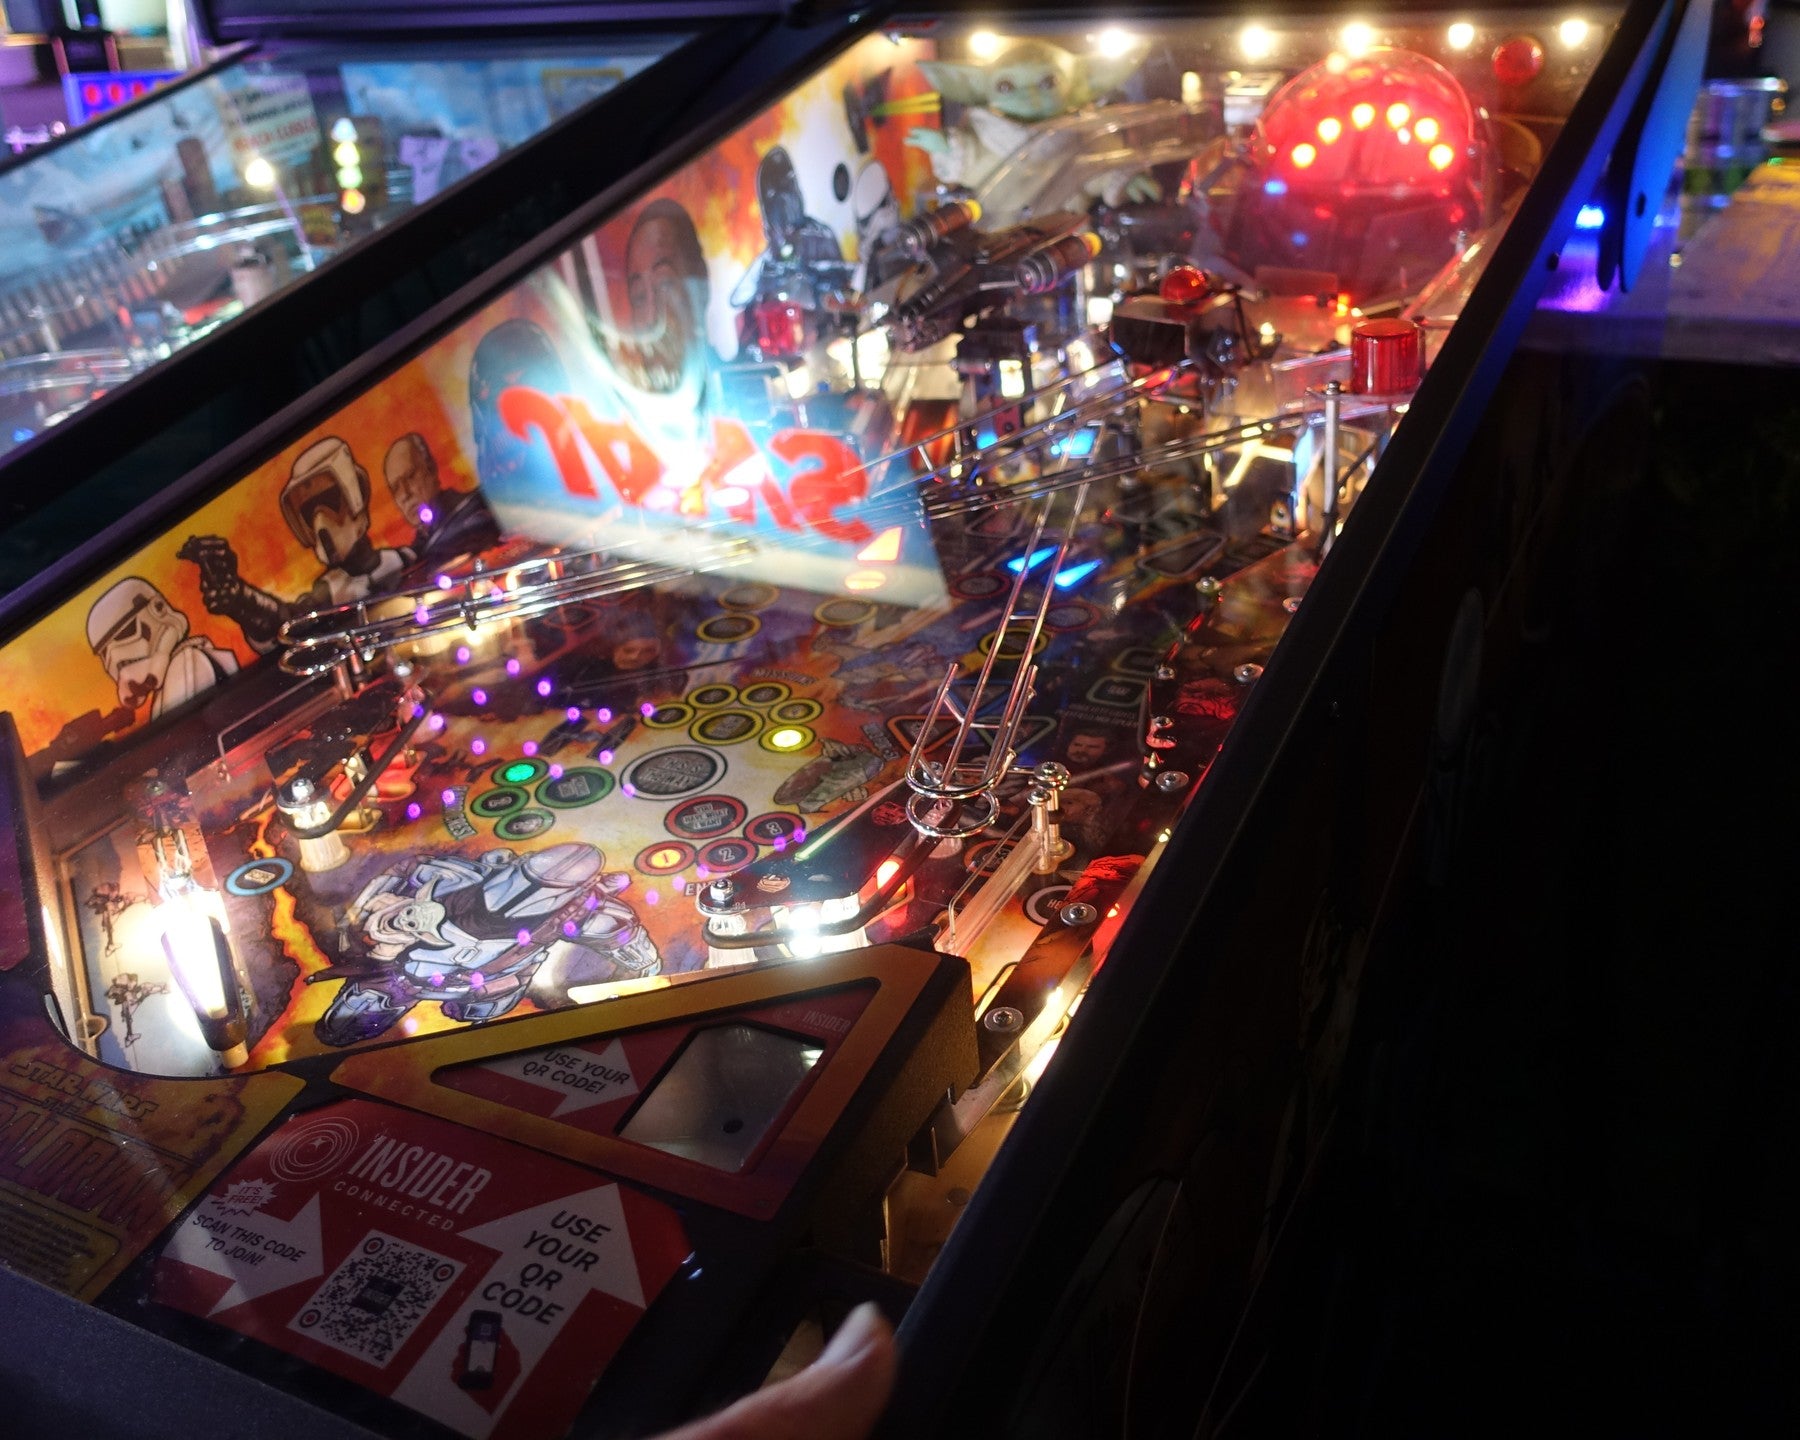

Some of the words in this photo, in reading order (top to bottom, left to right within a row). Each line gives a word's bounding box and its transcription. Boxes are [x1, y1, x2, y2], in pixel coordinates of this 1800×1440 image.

[765, 821, 783, 836] 3
[719, 847, 735, 862] 2
[802, 1010, 851, 1033] INSIDER
[522, 1061, 552, 1077] QR
[551, 1069, 607, 1095] CODE!
[542, 1050, 582, 1072] USE
[581, 1062, 630, 1085] YOUR
[9, 1060, 84, 1096] STAR
[80, 1077, 160, 1120] WARS
[240, 1186, 262, 1194] IT'S
[347, 1134, 492, 1214] INSIDER
[226, 1195, 264, 1204] FREE!
[333, 1181, 455, 1232] CONNECTED
[193, 1214, 232, 1234] SCAN
[230, 1226, 265, 1246] THIS
[263, 1240, 307, 1262] CODE
[550, 1210, 612, 1244] USE
[205, 1237, 226, 1251] TO
[224, 1244, 266, 1266] JOIN!
[522, 1230, 600, 1272] YOUR
[519, 1262, 563, 1291] QR
[481, 1282, 565, 1325] CODE
